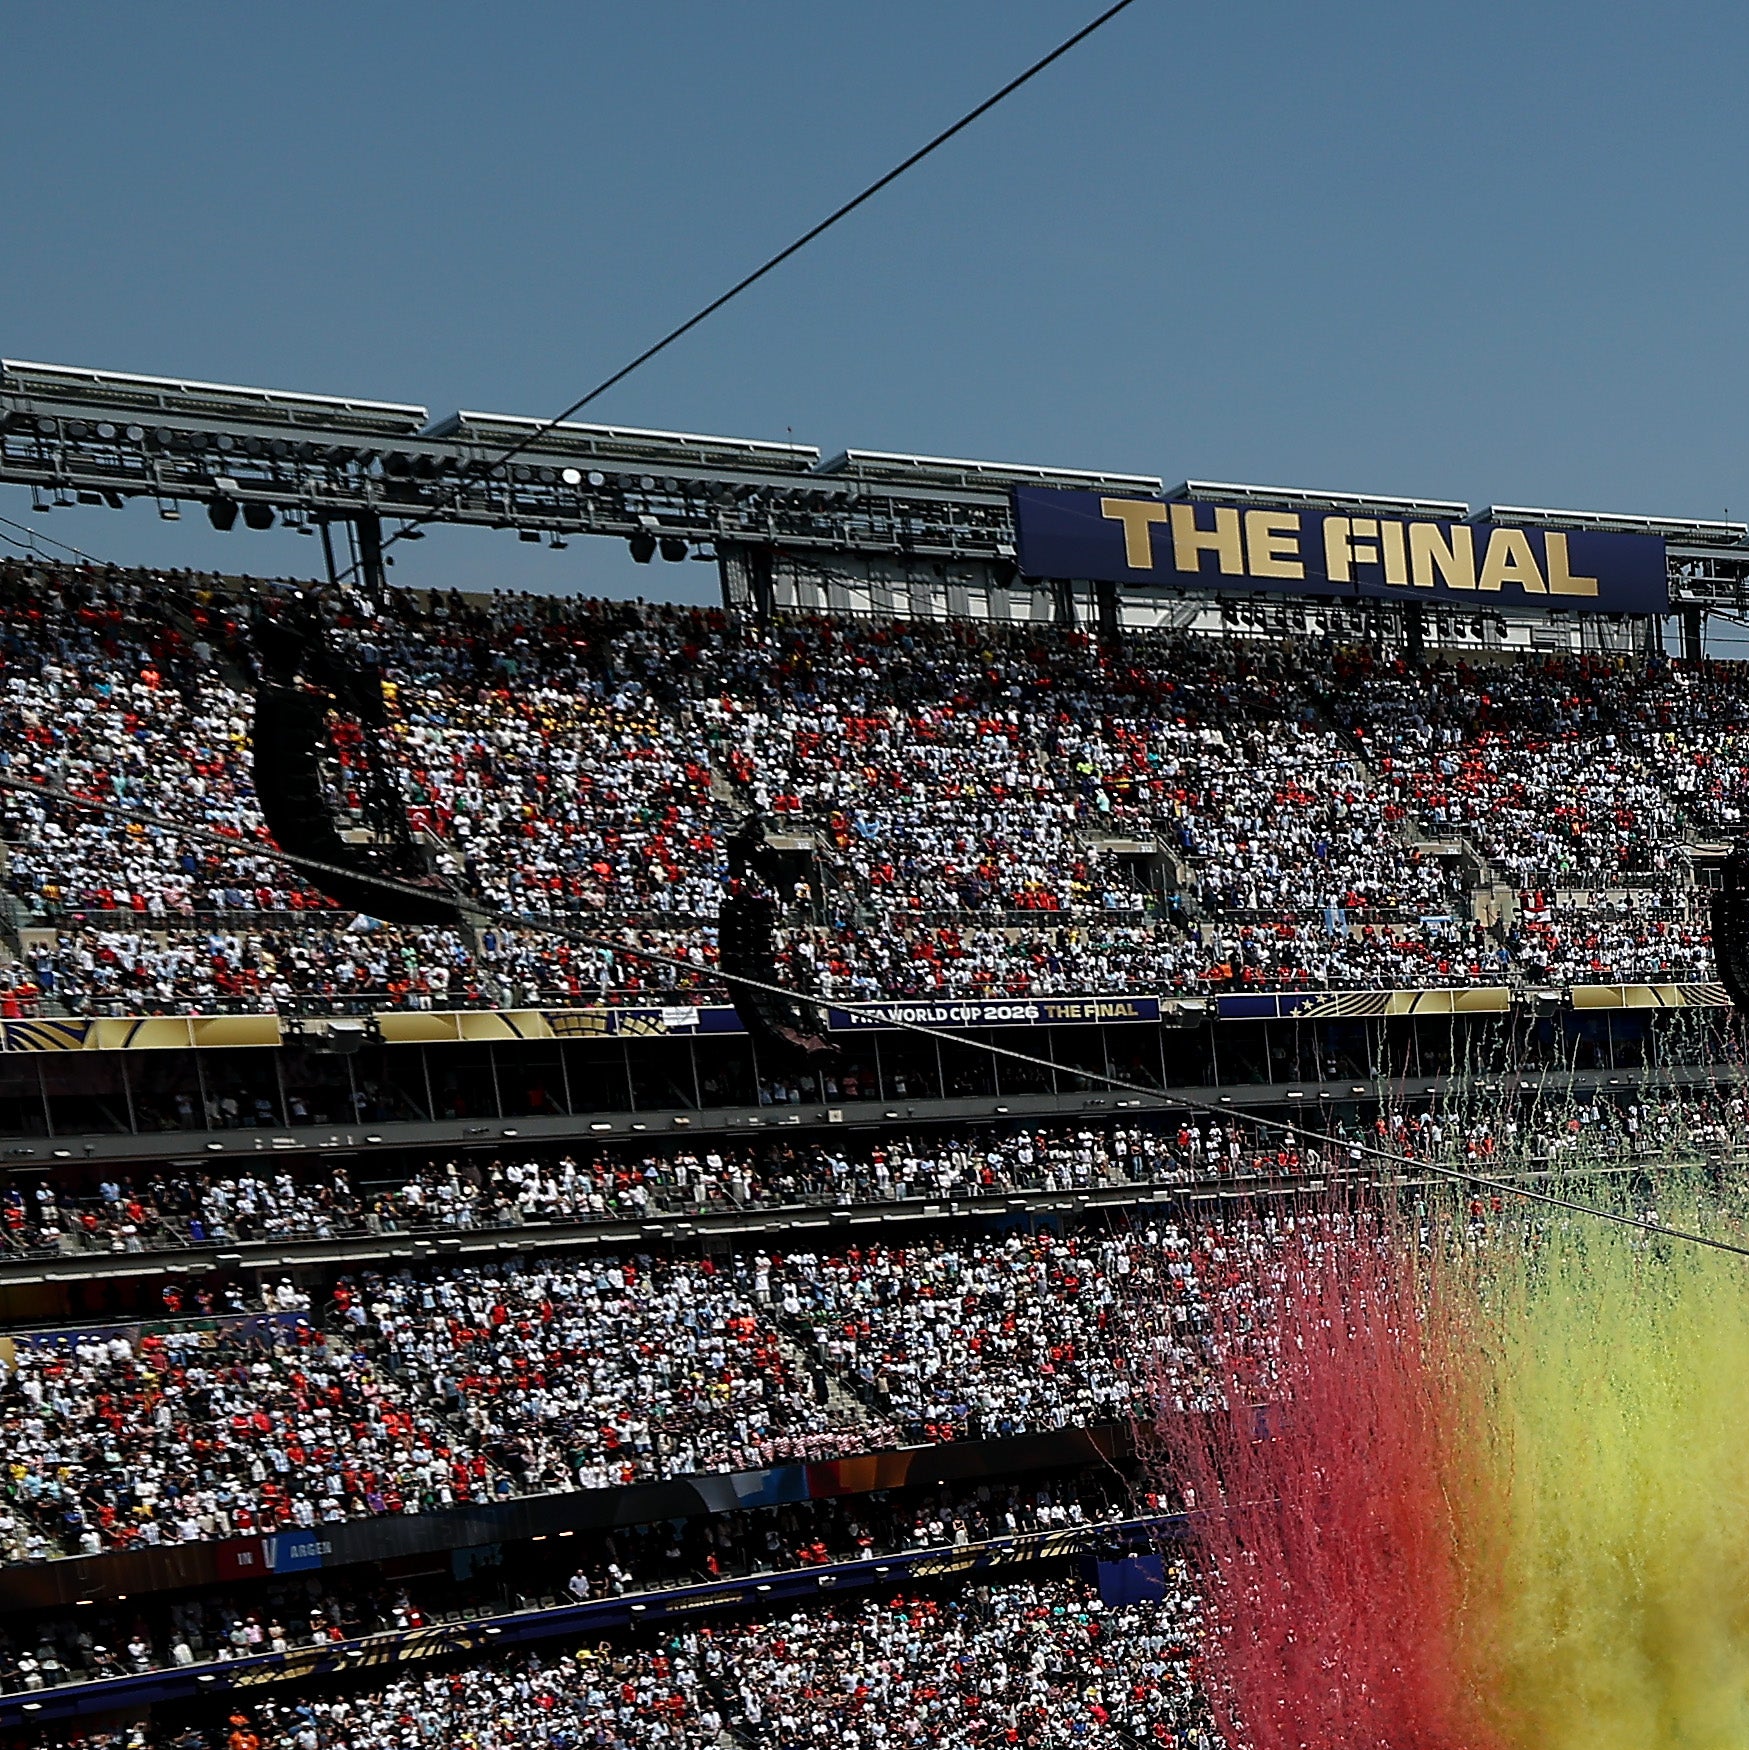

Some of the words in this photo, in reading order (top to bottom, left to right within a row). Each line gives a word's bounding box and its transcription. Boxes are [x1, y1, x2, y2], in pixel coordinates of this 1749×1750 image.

[1101, 497, 1305, 579] THE
[1323, 516, 1600, 596] FINAL
[850, 1008, 888, 1024] FIFA
[886, 1007, 947, 1023] WORLD
[948, 1006, 982, 1021] CUP
[983, 1005, 1039, 1020] 2026
[1043, 1004, 1082, 1019] THE
[1083, 1002, 1138, 1018] FINAL
